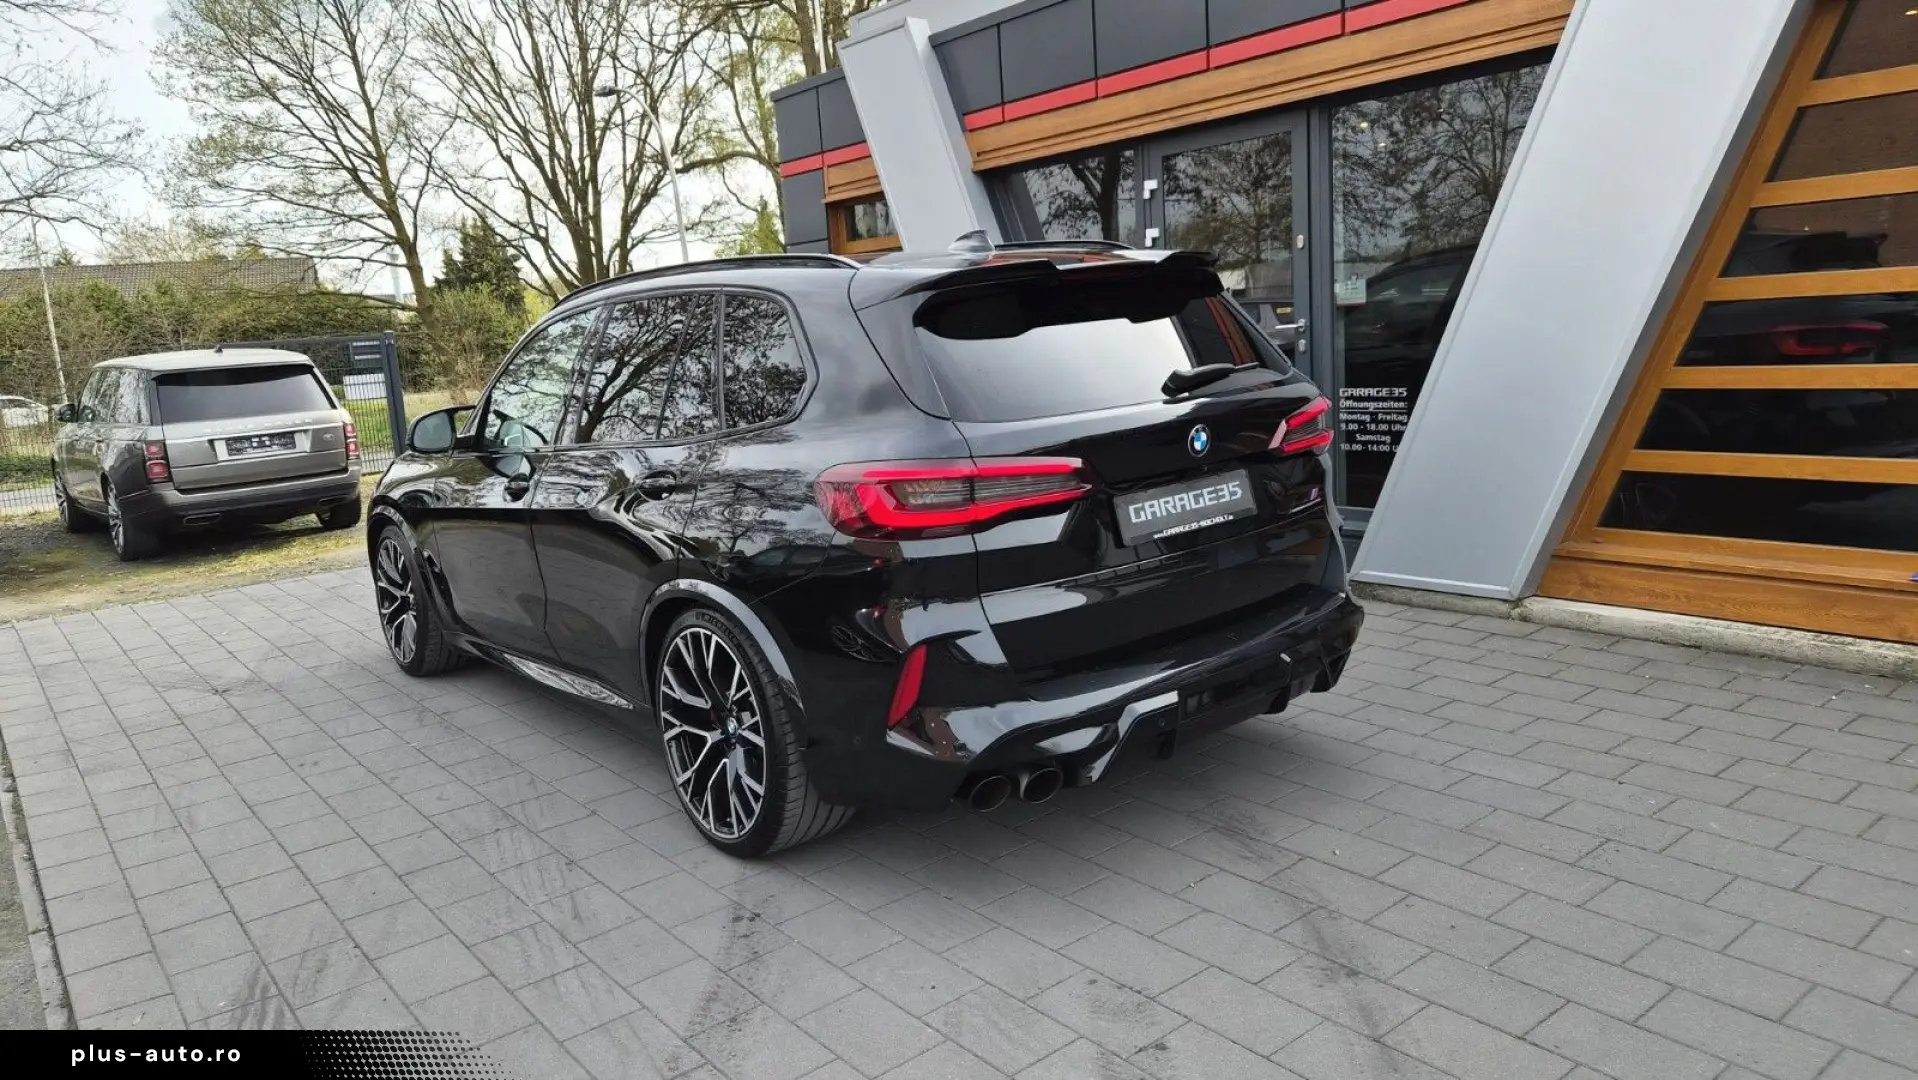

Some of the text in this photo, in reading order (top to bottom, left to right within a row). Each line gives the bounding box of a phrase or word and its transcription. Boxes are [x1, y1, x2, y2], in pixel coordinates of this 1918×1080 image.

[1339, 387, 1408, 398] GARAGE35
[1339, 398, 1408, 411] Öffnungszeiten:
[1339, 413, 1371, 422] Montag
[1377, 413, 1408, 423] Freitag
[1340, 423, 1359, 431] 9.00
[1366, 423, 1389, 431] 18.00
[1355, 433, 1391, 444] Samstag
[1128, 481, 1243, 524] GARAGE35
